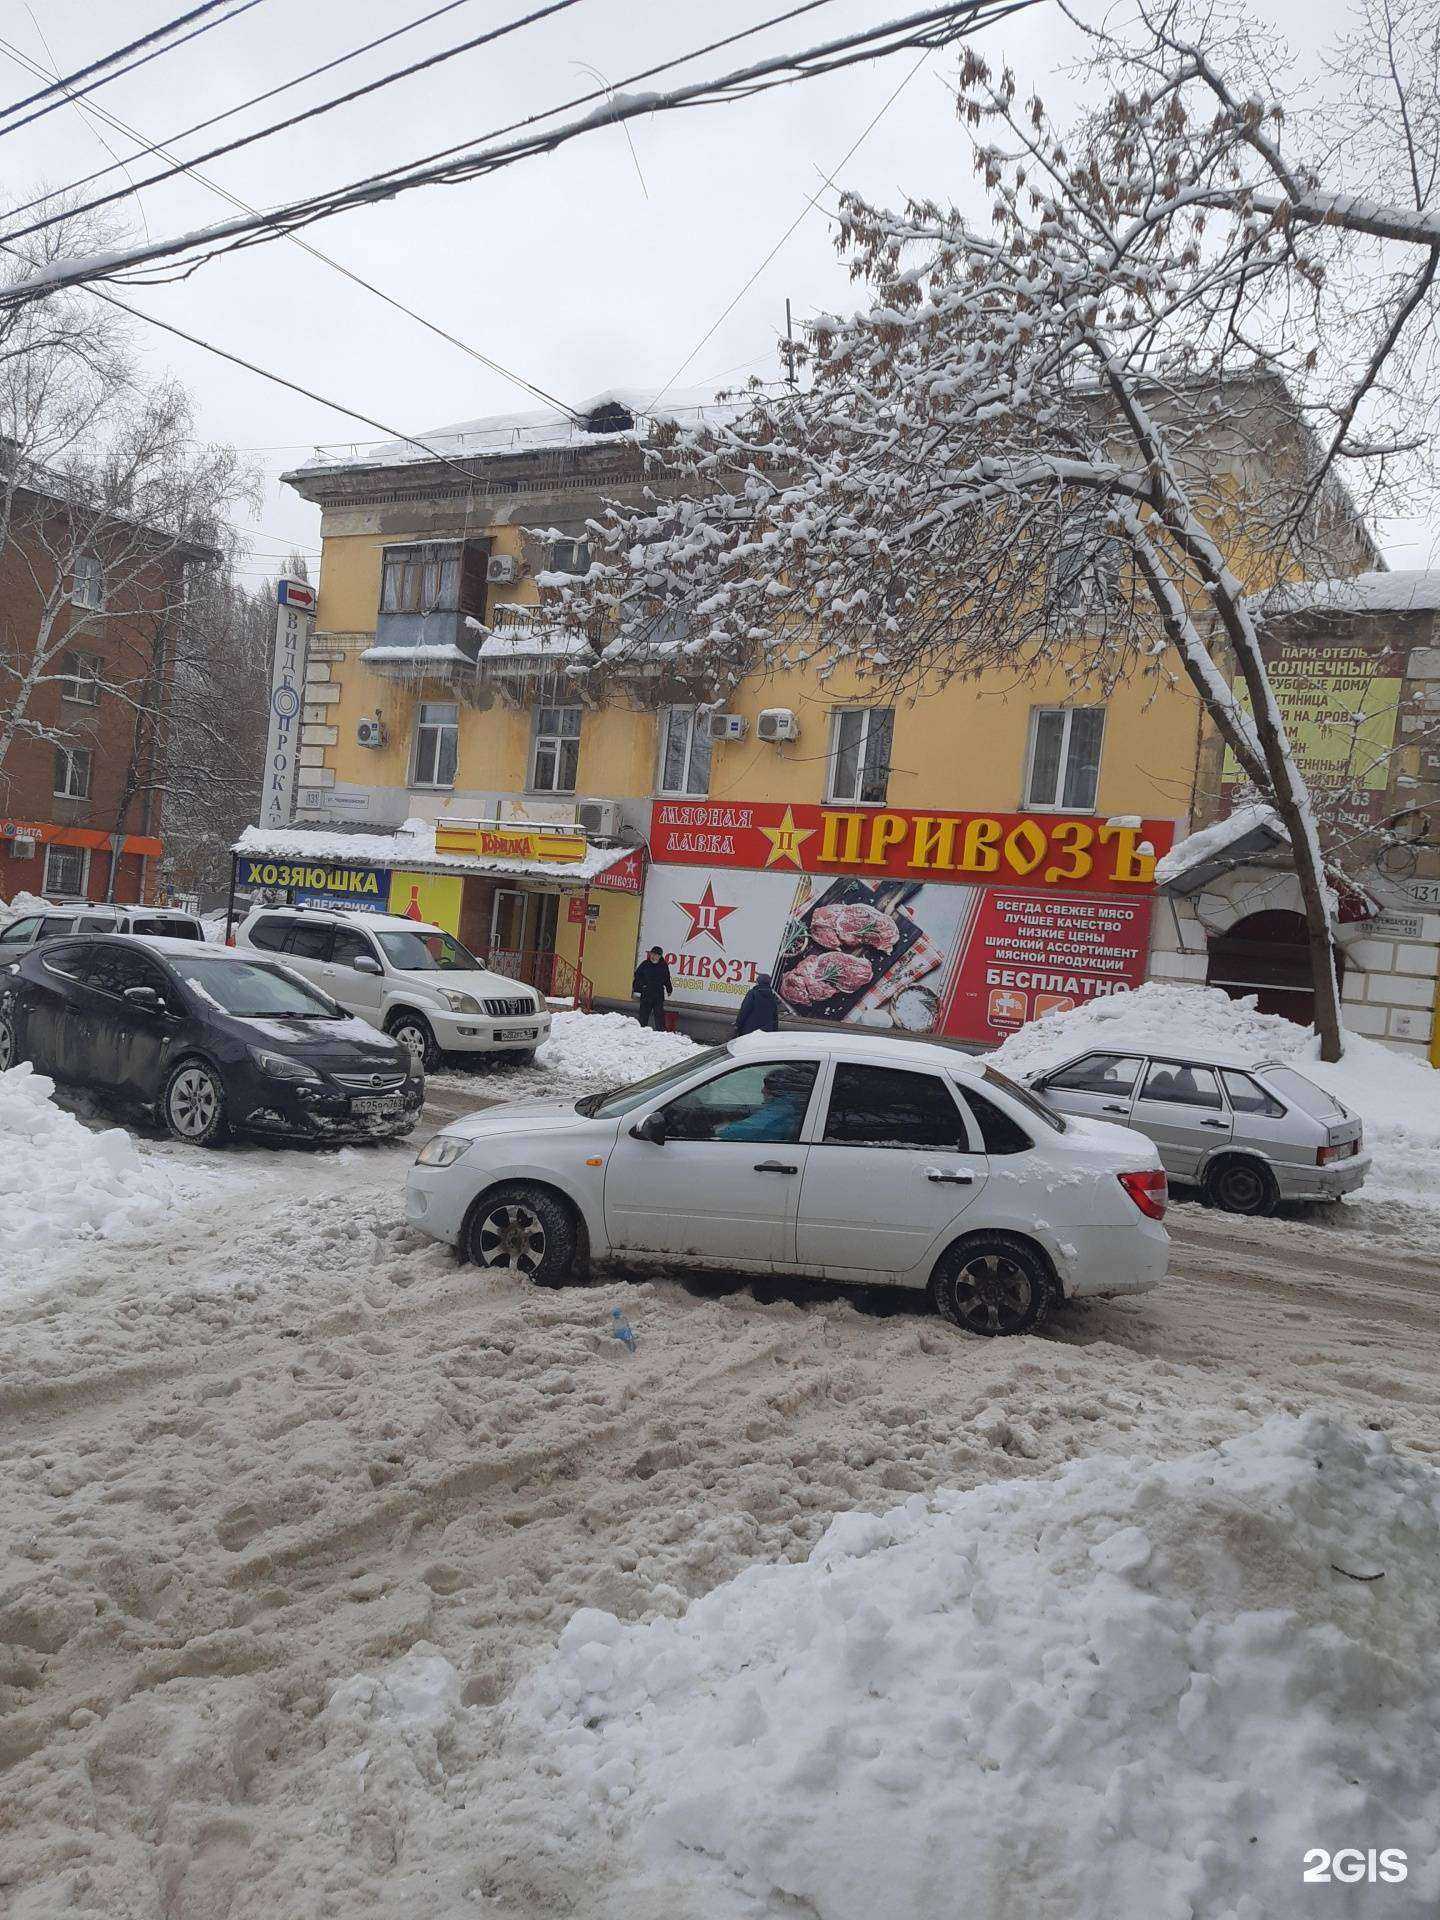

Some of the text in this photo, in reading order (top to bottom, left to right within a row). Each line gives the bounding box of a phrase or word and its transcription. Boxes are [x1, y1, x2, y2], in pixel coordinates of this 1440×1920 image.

[1282, 648, 1367, 659] ПАРК-ОТЕЛЬ
[1267, 660, 1378, 676] СОЛНЕЧНЫЙ
[1268, 678, 1369, 692] РУБОВЫЕ ДОМА
[1294, 711, 1309, 721] НА
[658, 806, 753, 829] МЯСНАЯ
[16, 826, 42, 837] ВИТА
[666, 832, 736, 855] ЛАВКА
[817, 811, 1157, 884] ПРИВОЗЪ
[248, 863, 379, 894] ХОЗЯЮШКА
[600, 873, 638, 889] ПРИВОЗЪ
[697, 905, 717, 930] П
[996, 901, 1134, 920] ВСЕГДА СВЕЖЕЕ МЯСО
[1005, 913, 1122, 932] ЛУЧШЕЕ КАЧЕСТВО
[1018, 927, 1105, 943] НИЗКИЕ ЦЕНЫ
[985, 936, 1139, 959] ШИРОКИЙ АССОРТИМЕНТ
[996, 949, 1124, 970] МЯСНОЙ ПРОДУКЦИИ
[986, 969, 1130, 996] БЕСПЛАТНО
